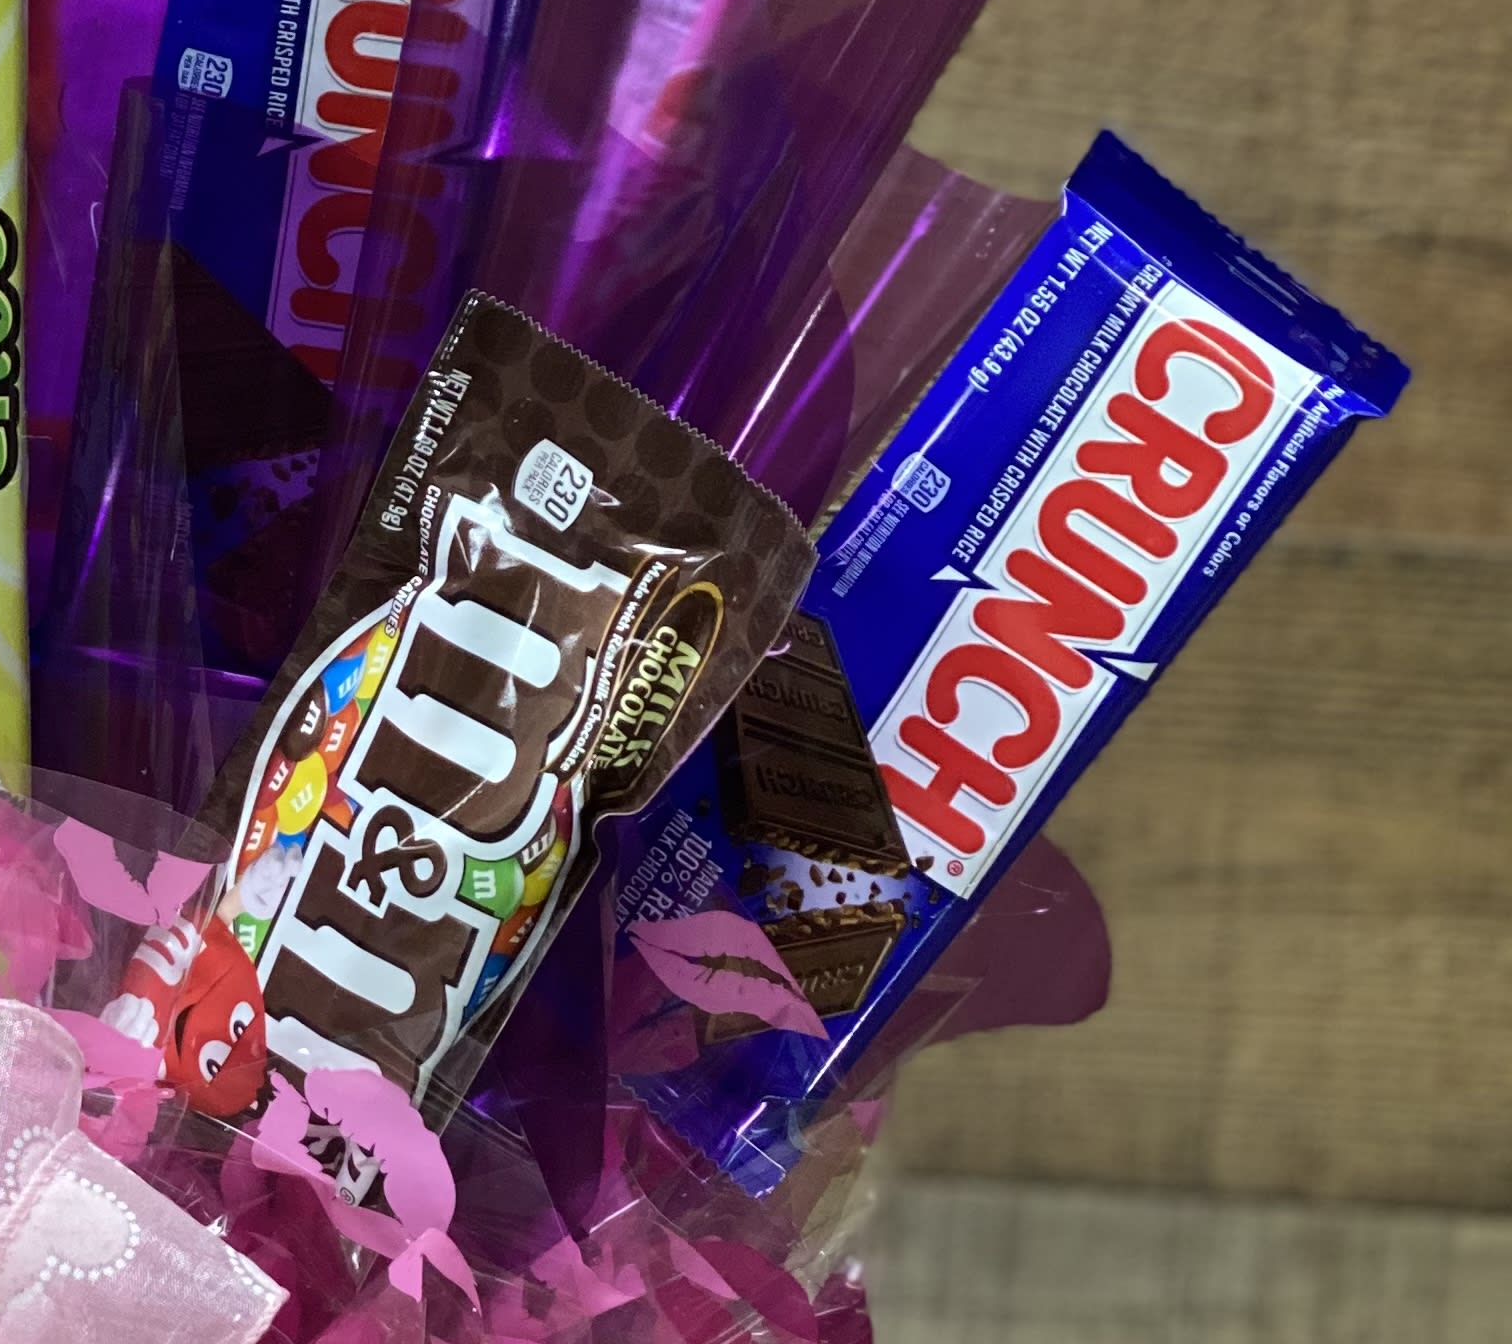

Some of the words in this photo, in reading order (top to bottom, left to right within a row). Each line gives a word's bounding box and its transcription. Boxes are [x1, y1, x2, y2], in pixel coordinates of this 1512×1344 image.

[269, 19, 299, 87] CRISPED
[200, 57, 228, 97] 230
[263, 91, 288, 127] RICE
[1077, 220, 1114, 254] NET
[1055, 245, 1089, 281] WT
[1029, 272, 1068, 313] 1.55
[1113, 262, 1163, 318] CREAMY
[1011, 306, 1043, 336] OZ
[1090, 312, 1126, 353] MILK
[440, 367, 472, 401] NET
[1038, 347, 1103, 433] CHOCOLATE
[1323, 383, 1344, 404] No
[428, 396, 457, 426] WT
[1280, 398, 1331, 463] Artificial
[412, 419, 445, 457] 1.69
[533, 449, 549, 470] PER
[1013, 425, 1051, 469] WITH
[402, 452, 429, 480] OZ
[521, 468, 539, 493] PACK
[527, 451, 563, 505] CALORIES
[1245, 457, 1291, 515] Flavors
[378, 476, 418, 532] (47.9g)
[540, 461, 590, 525] 230
[908, 466, 948, 511] 230
[973, 462, 1026, 530] CRISPED
[416, 484, 441, 575] CHOCOLATE
[1233, 510, 1253, 532] or
[951, 524, 986, 563] RICE
[1201, 528, 1242, 581] Colors
[631, 557, 667, 603] Made
[879, 316, 1276, 856] CRUNCH
[382, 575, 424, 638] CANDIES
[614, 598, 639, 633] with
[598, 632, 623, 668] Real
[588, 667, 615, 701] Milk
[592, 624, 678, 771] CHOCOLATE
[613, 638, 701, 768] MILK
[558, 701, 604, 775] Chocolate
[658, 809, 693, 850] MILK
[661, 831, 711, 890] 100%
[683, 858, 724, 906] MADE
